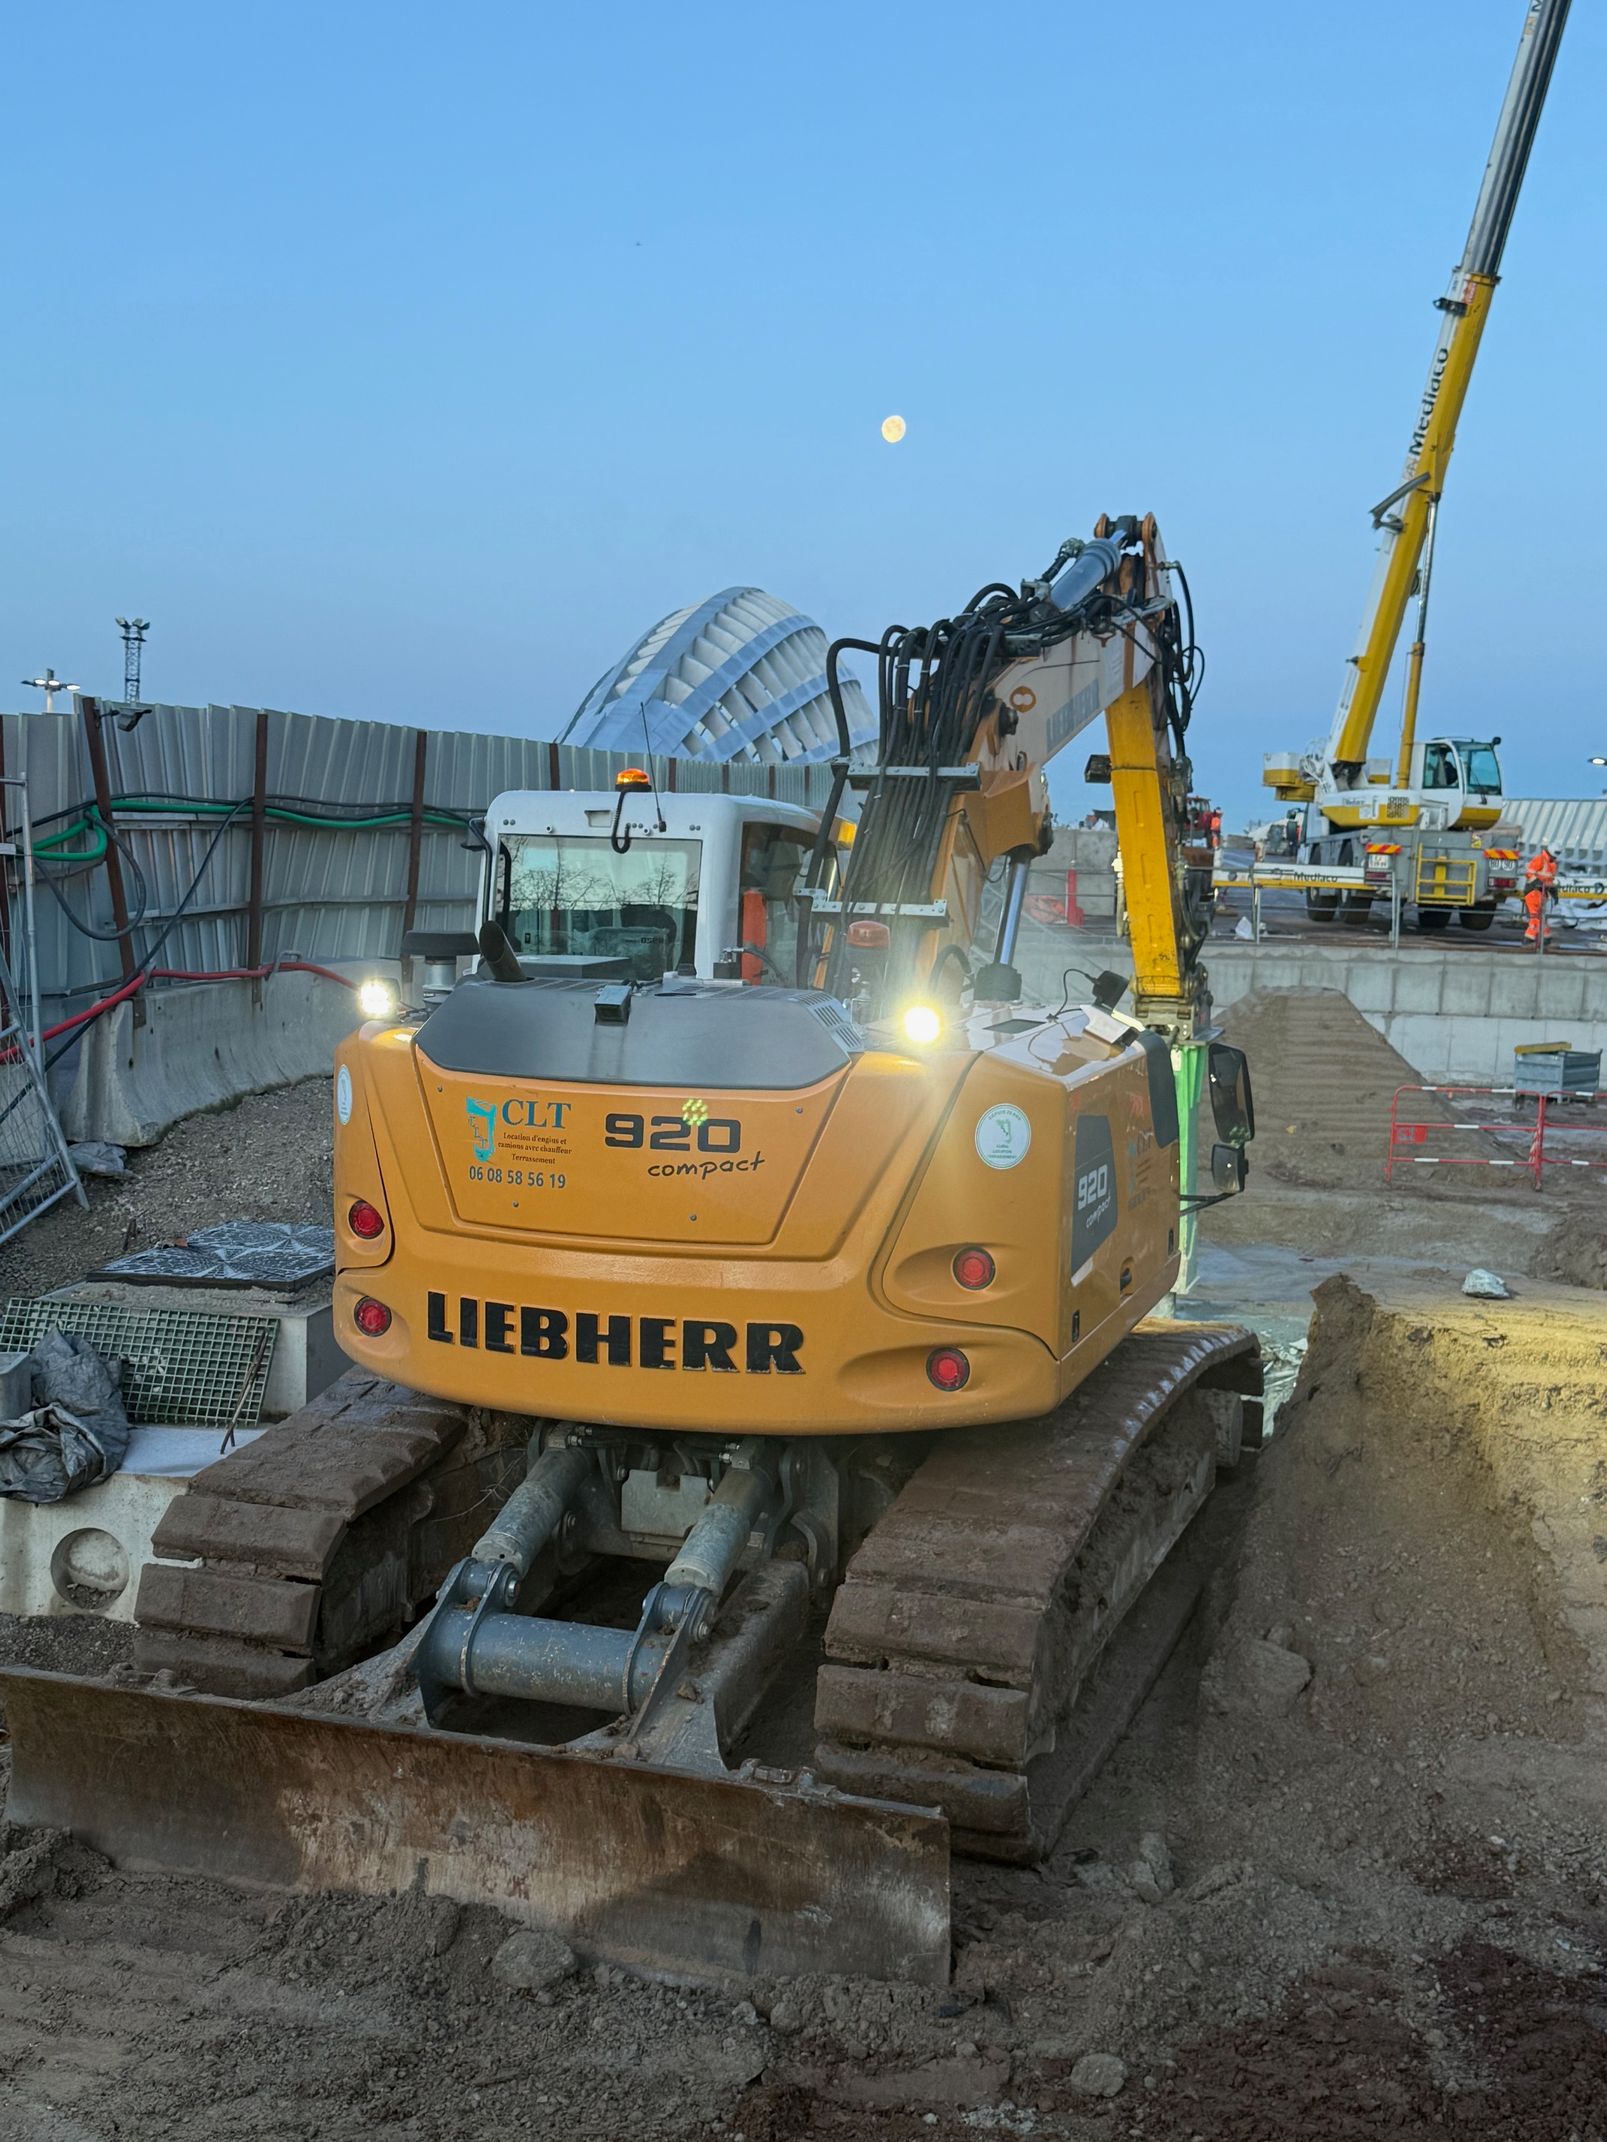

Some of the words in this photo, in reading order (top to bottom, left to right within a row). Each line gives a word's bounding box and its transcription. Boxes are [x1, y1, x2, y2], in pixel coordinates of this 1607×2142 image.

[1409, 348, 1449, 456] Mediaco
[502, 1099, 571, 1129] CLT
[503, 1132, 531, 1141] Location
[531, 1134, 560, 1144] d'engins
[605, 1113, 741, 1153] 920
[498, 1142, 524, 1150] camions
[540, 1145, 572, 1155] chauffeur
[512, 1153, 556, 1164] Terrassement
[469, 1165, 483, 1180] 06
[487, 1168, 502, 1183] 08
[507, 1169, 523, 1185] 58
[528, 1171, 544, 1187] 56
[549, 1173, 566, 1189] 19
[647, 1151, 765, 1180] compact
[1078, 1164, 1108, 1211] 920
[427, 1291, 806, 1374] LIEBHERR
